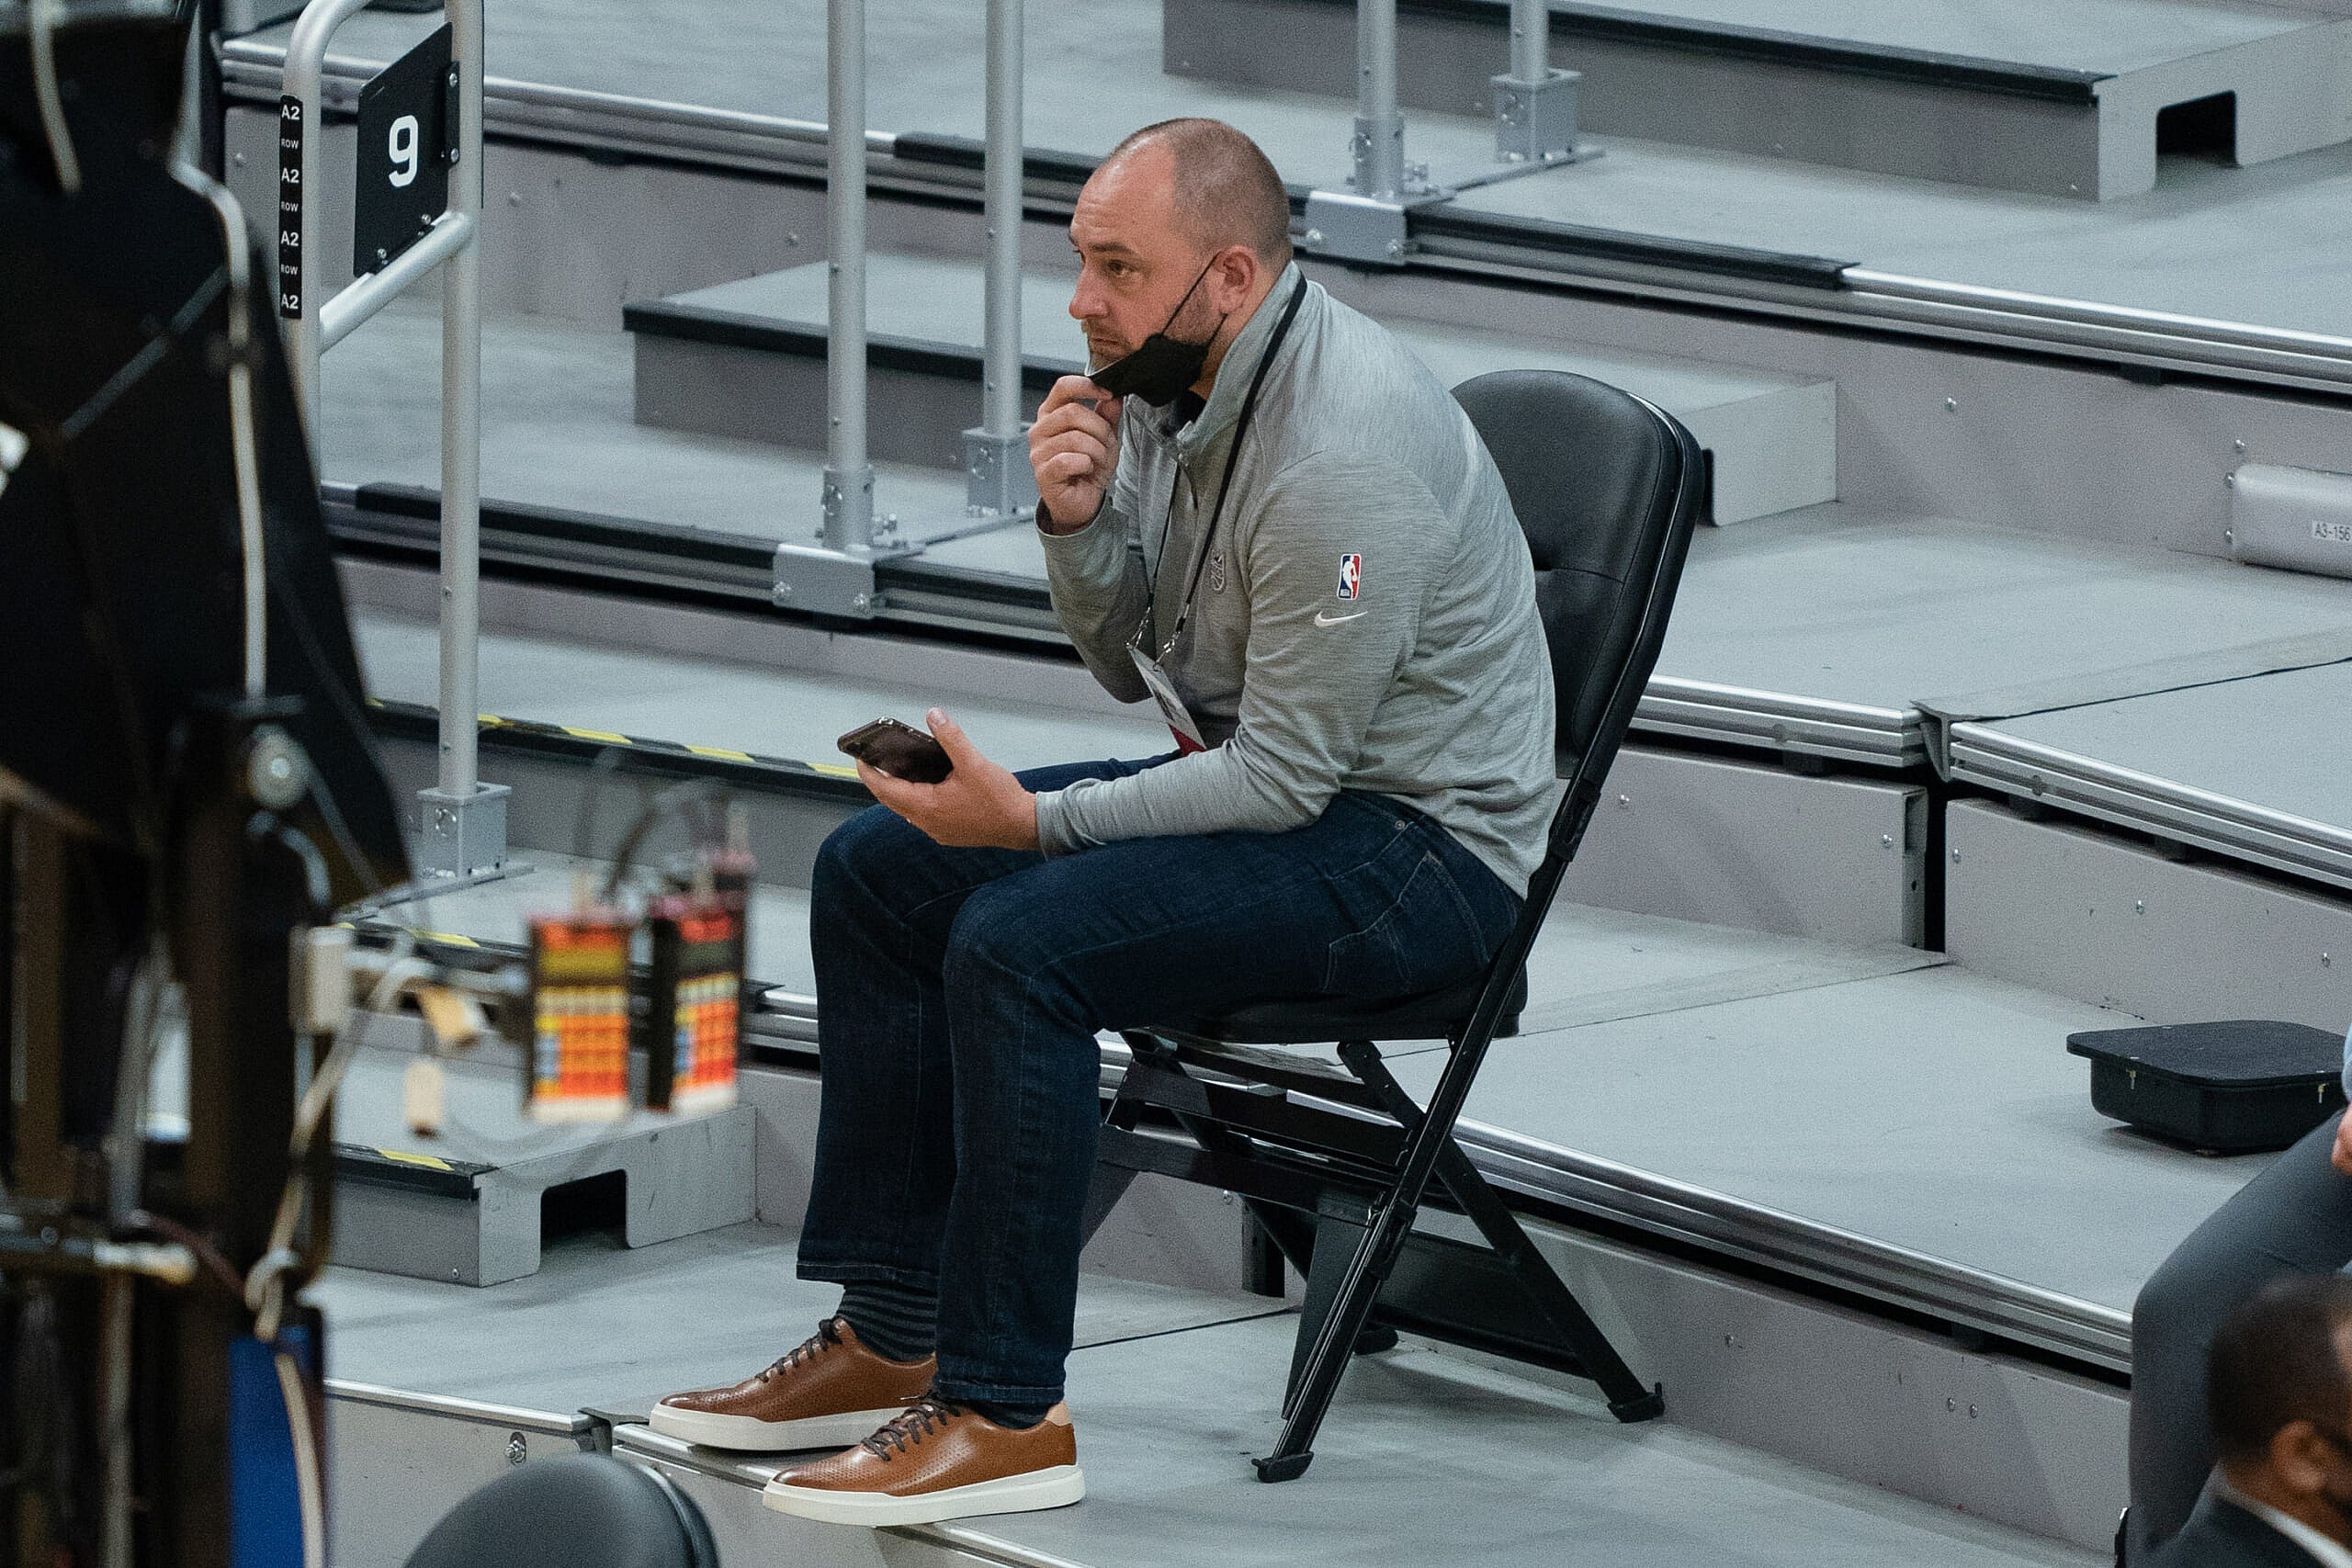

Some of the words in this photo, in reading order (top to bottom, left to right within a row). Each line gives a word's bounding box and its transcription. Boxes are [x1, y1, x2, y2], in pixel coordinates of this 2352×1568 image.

[281, 104, 300, 120] A2
[281, 139, 300, 149] ROW
[389, 115, 418, 187] 9
[281, 167, 300, 184] A2
[280, 231, 300, 247] A2
[280, 294, 299, 310] A2
